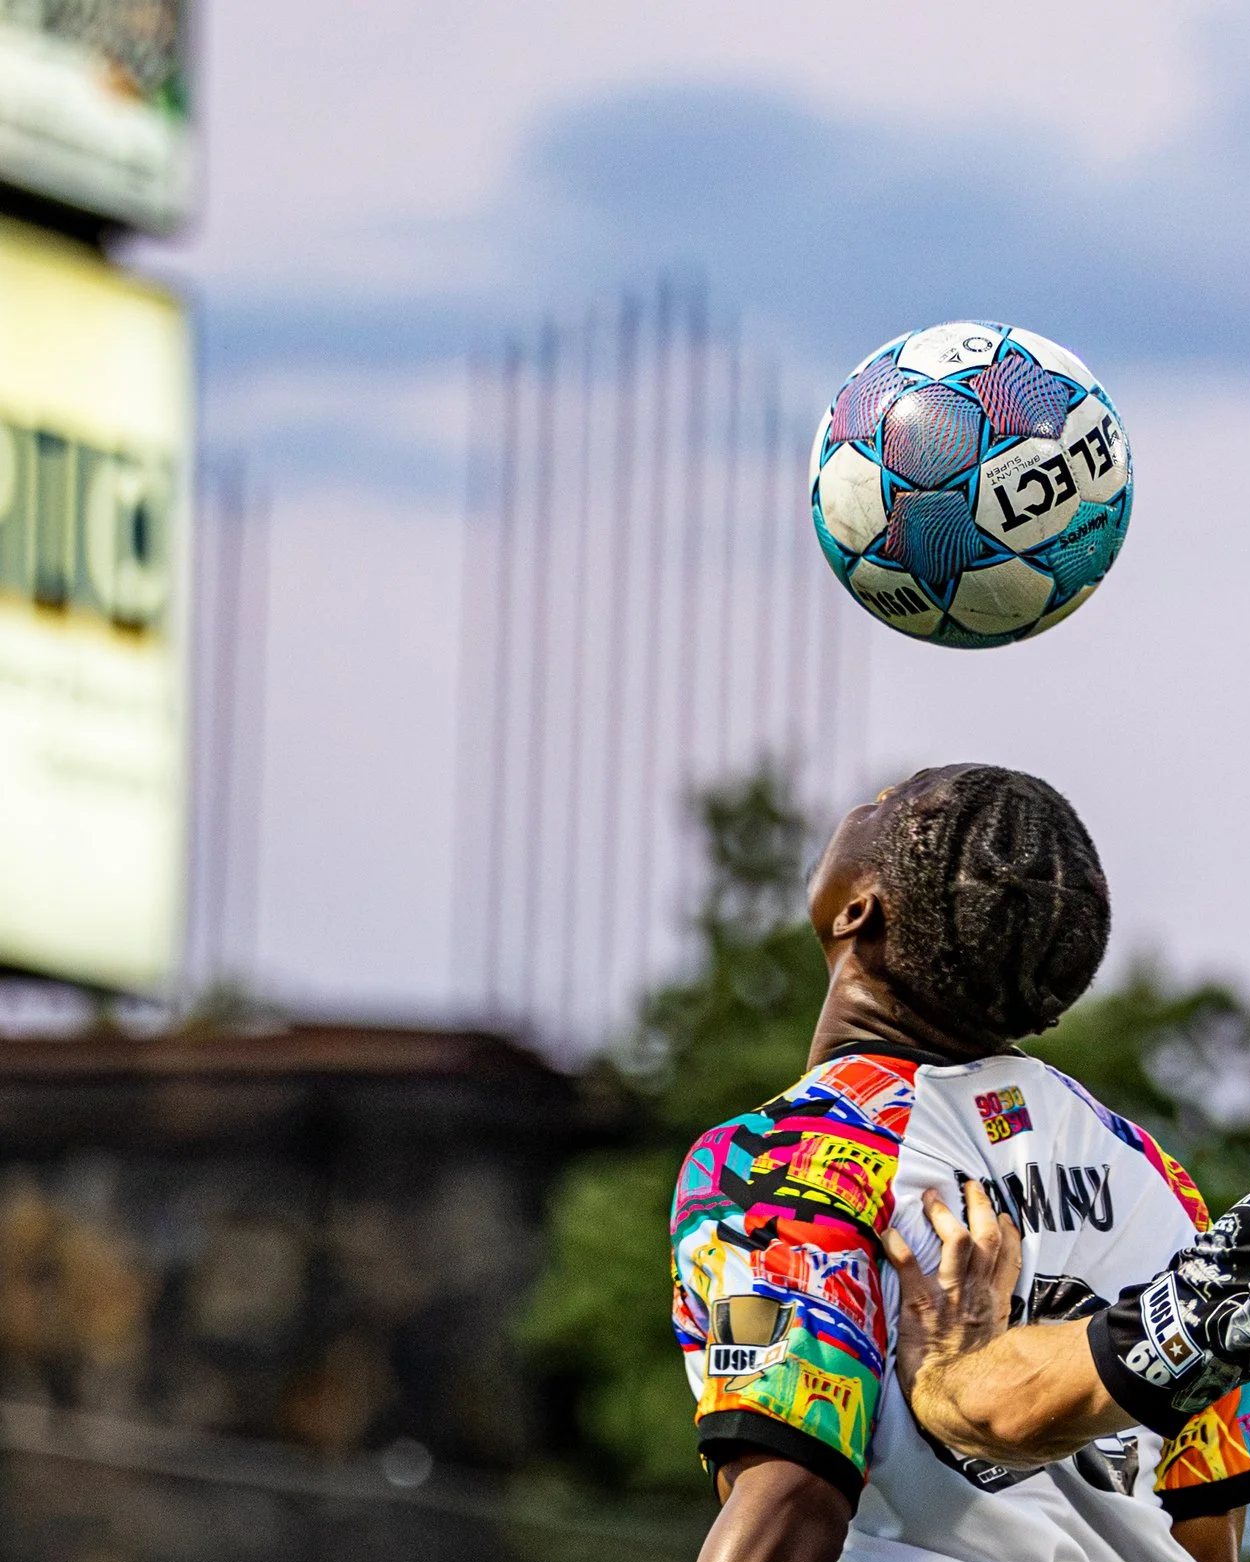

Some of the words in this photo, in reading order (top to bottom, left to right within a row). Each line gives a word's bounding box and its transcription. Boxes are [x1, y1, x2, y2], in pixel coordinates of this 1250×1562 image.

[986, 456, 1022, 479] SUPER
[991, 455, 1041, 486] BRILLANT
[1149, 1283, 1175, 1345] USL
